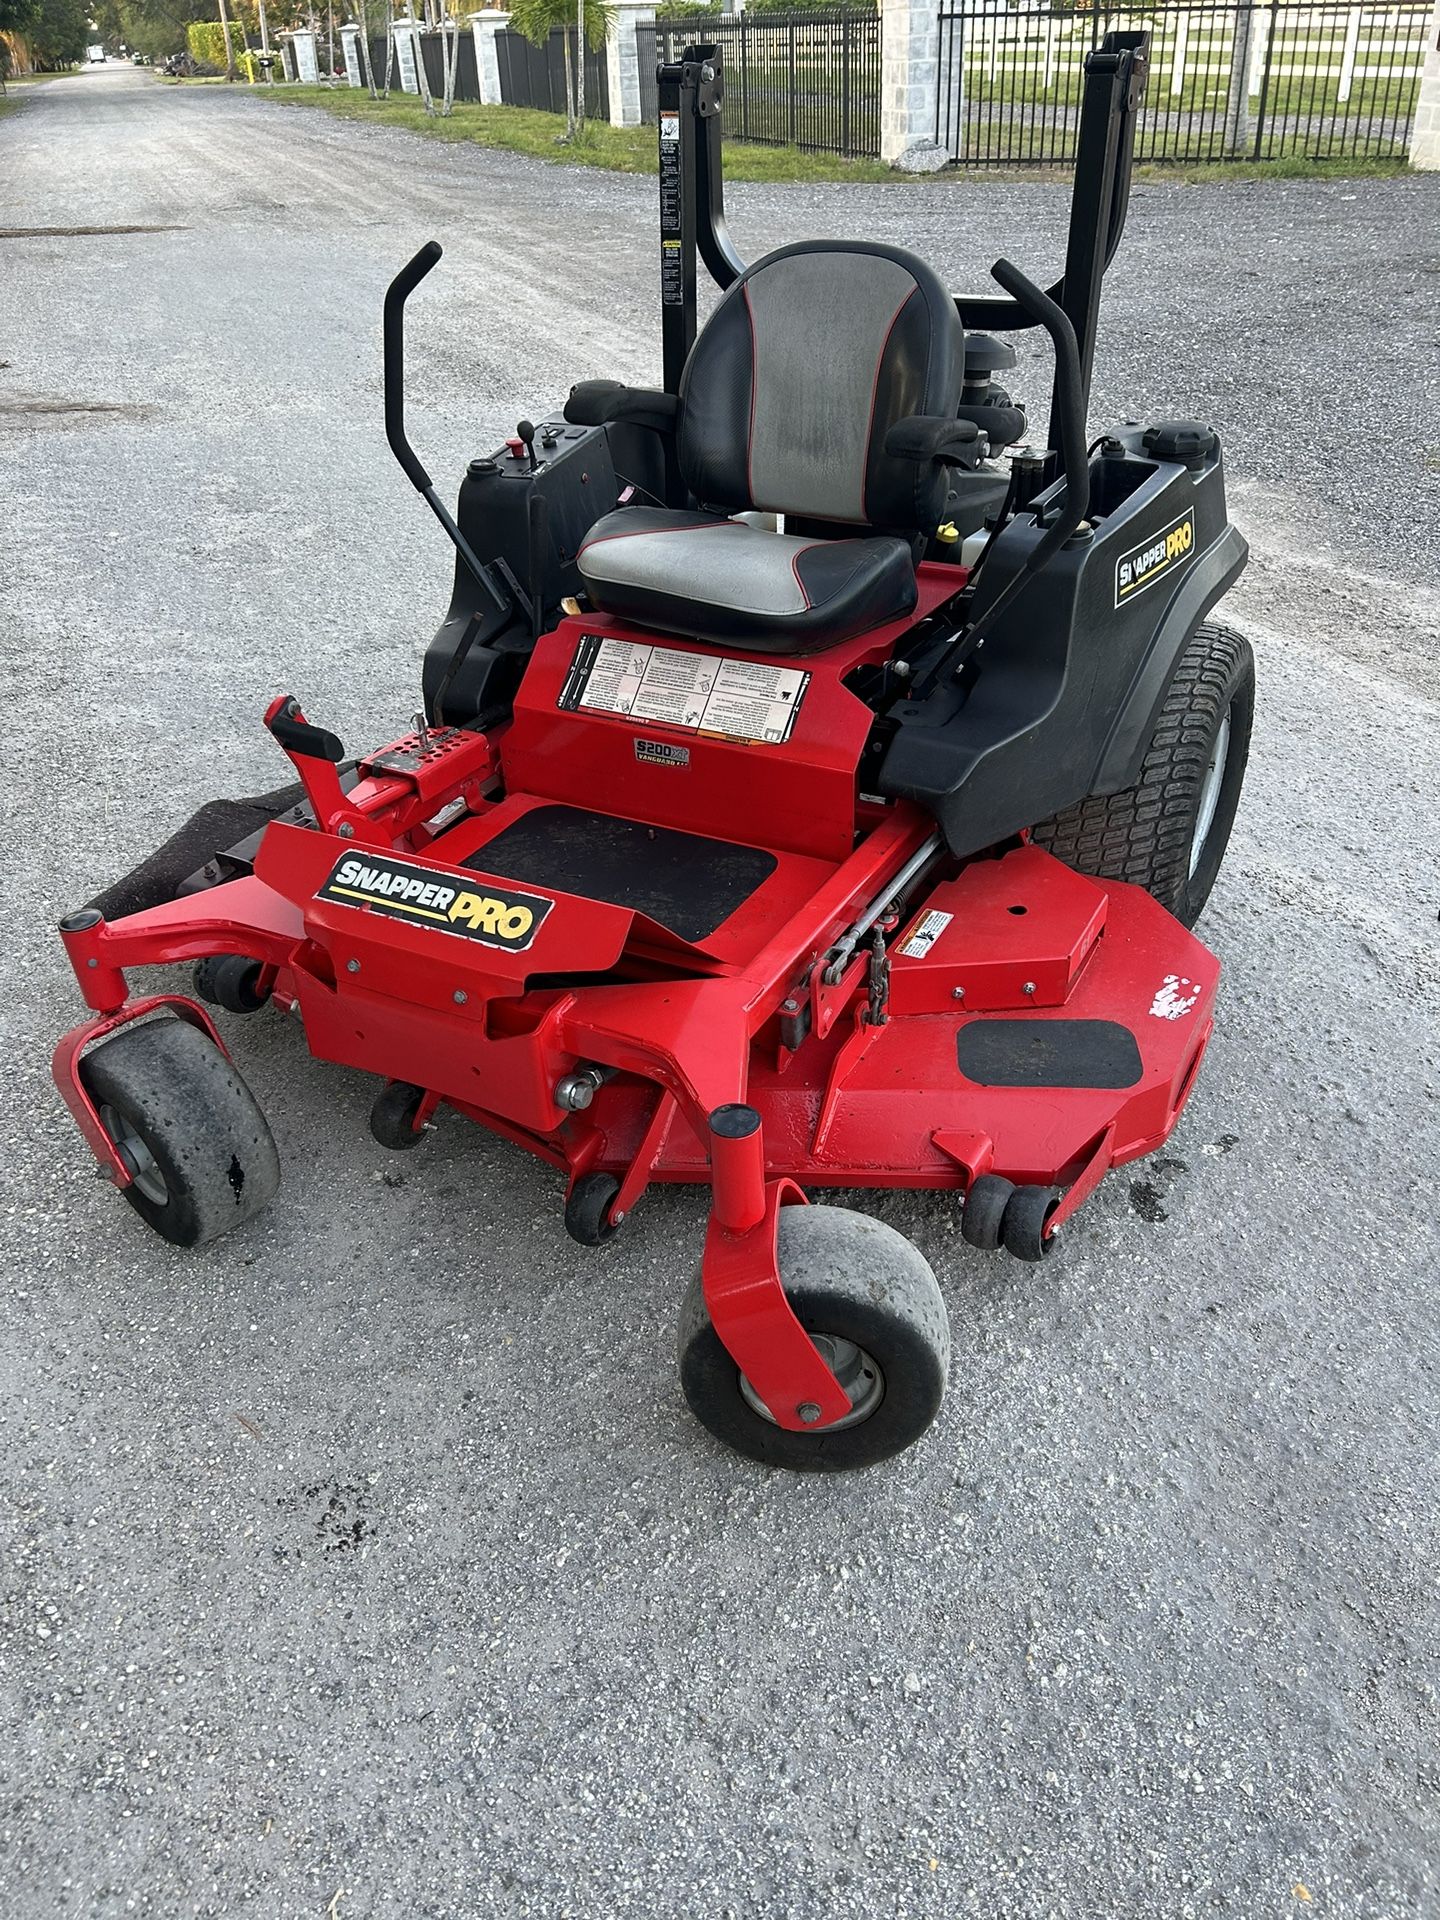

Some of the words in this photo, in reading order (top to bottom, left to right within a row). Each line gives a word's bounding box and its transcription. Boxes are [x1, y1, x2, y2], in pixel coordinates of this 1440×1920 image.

[1166, 521, 1192, 560] PRO
[335, 860, 455, 910] SNAPPER
[447, 891, 534, 939] PRO
